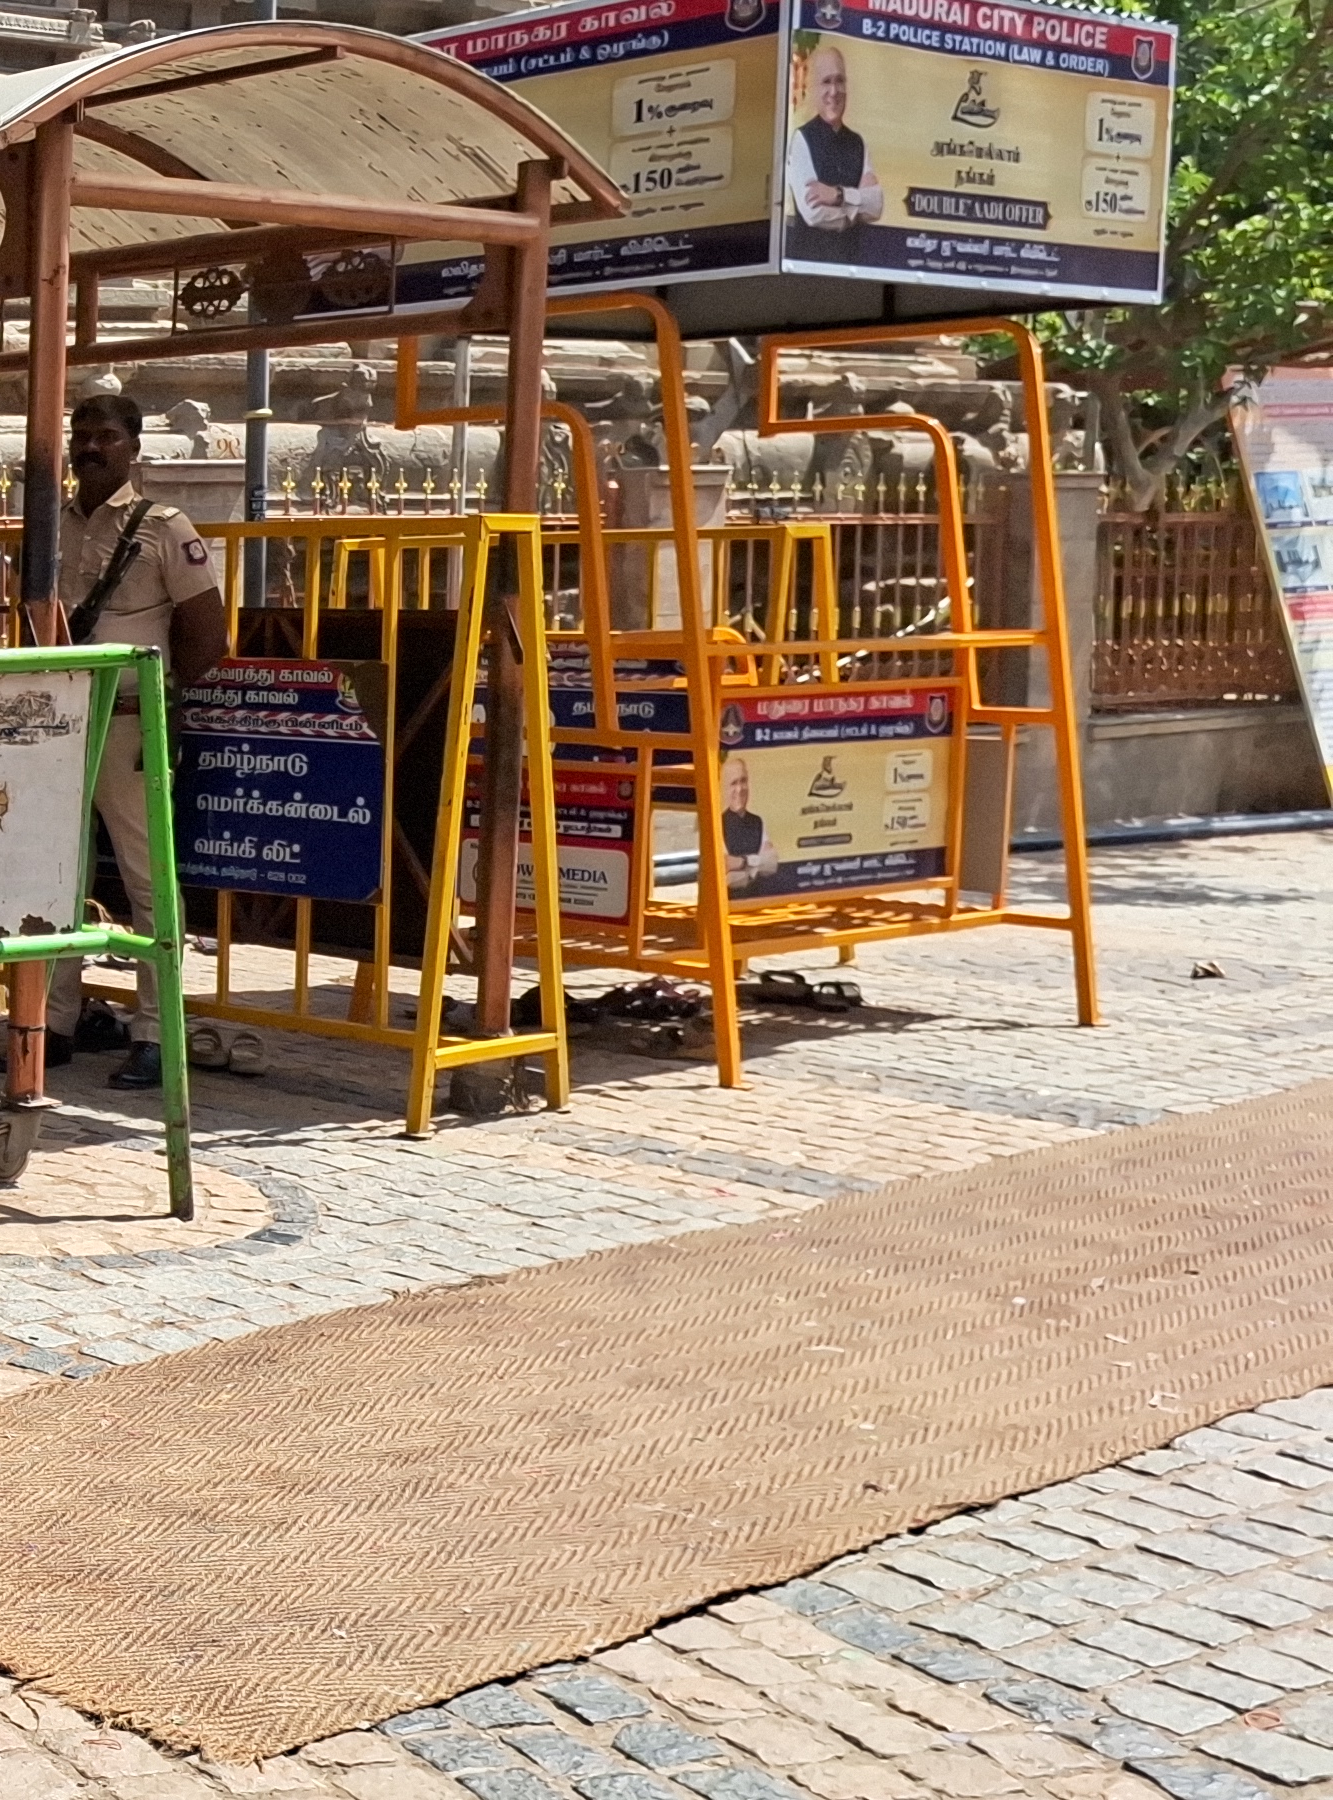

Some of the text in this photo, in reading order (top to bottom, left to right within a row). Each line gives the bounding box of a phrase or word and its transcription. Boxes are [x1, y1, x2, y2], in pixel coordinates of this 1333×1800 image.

[975, 6, 1028, 37] CITY
[1032, 17, 1110, 49] POLICE
[862, 18, 1110, 77] B-2 POLICE STATION (LAW & ORDER)
[1005, 204, 1045, 225] OFFER
[279, 666, 334, 684] காவல்
[197, 743, 309, 778] தமிழ்நாடு
[196, 787, 372, 825] மெர்க்கன்டைல்
[194, 830, 302, 864] வங்கி லிட்
